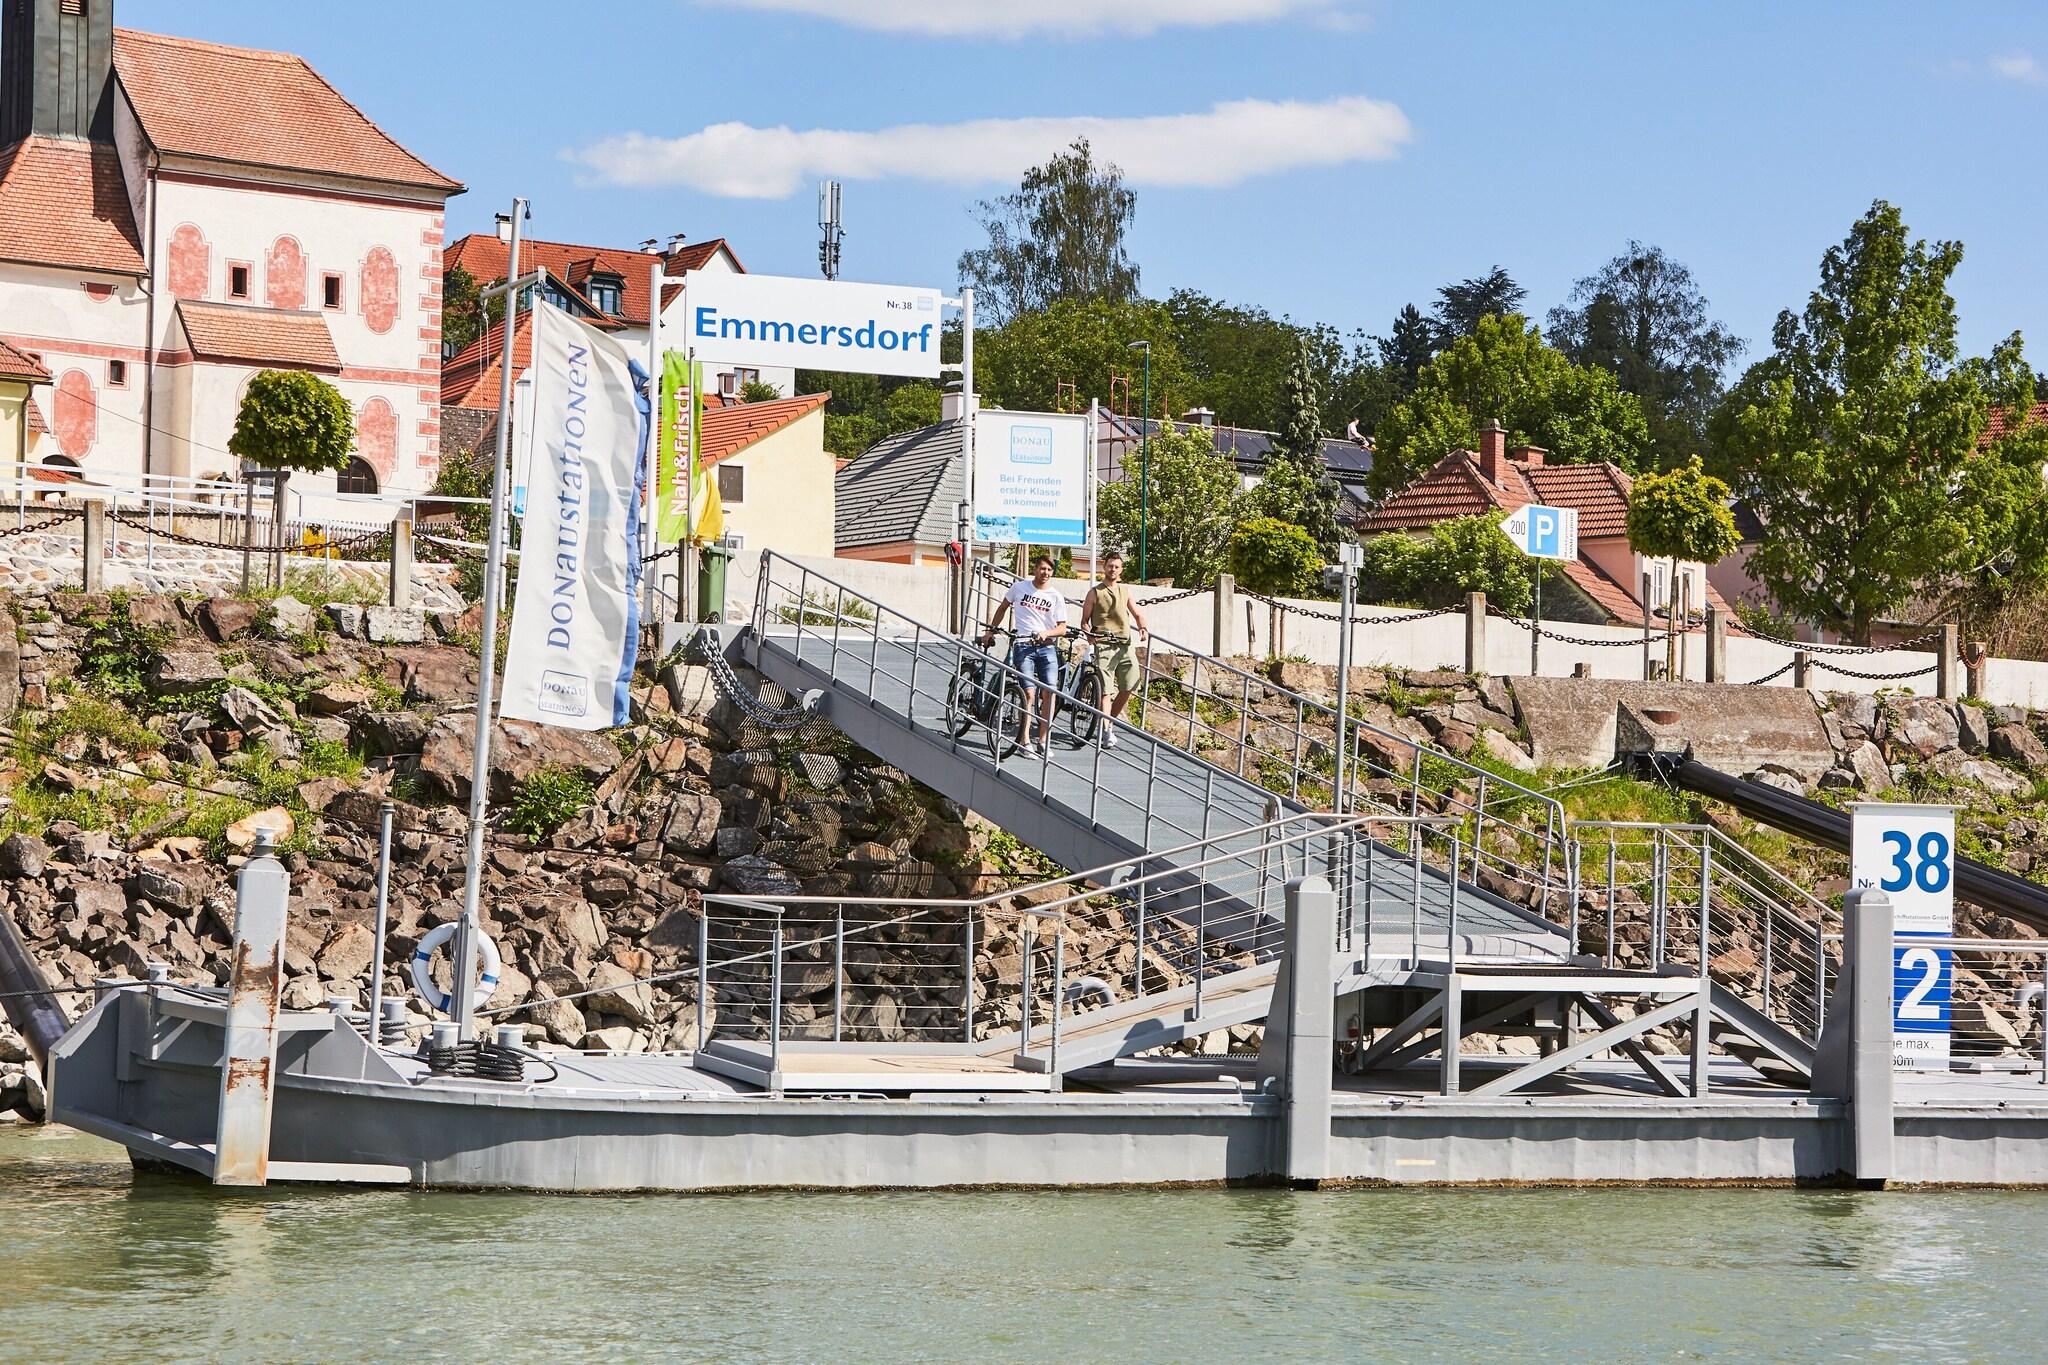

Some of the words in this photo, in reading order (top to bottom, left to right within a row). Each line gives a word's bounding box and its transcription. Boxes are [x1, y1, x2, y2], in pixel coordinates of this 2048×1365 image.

[695, 306, 933, 353] Emmersdorf
[671, 385, 690, 517] Nah&Frisch
[1000, 474, 1015, 483] Bei
[1018, 475, 1061, 486] Freunden
[1000, 487, 1026, 496] erster
[1030, 487, 1061, 497] Klasse
[1003, 498, 1057, 508] ankommen!
[1510, 520, 1526, 535] 200
[1536, 514, 1554, 549] P
[1021, 594, 1040, 605] JUST
[1040, 598, 1052, 608] DO
[1880, 830, 1950, 894] 38
[1858, 878, 1876, 889] Nr.
[1897, 948, 1941, 1019] 2
[1906, 1040, 1934, 1049] max.
